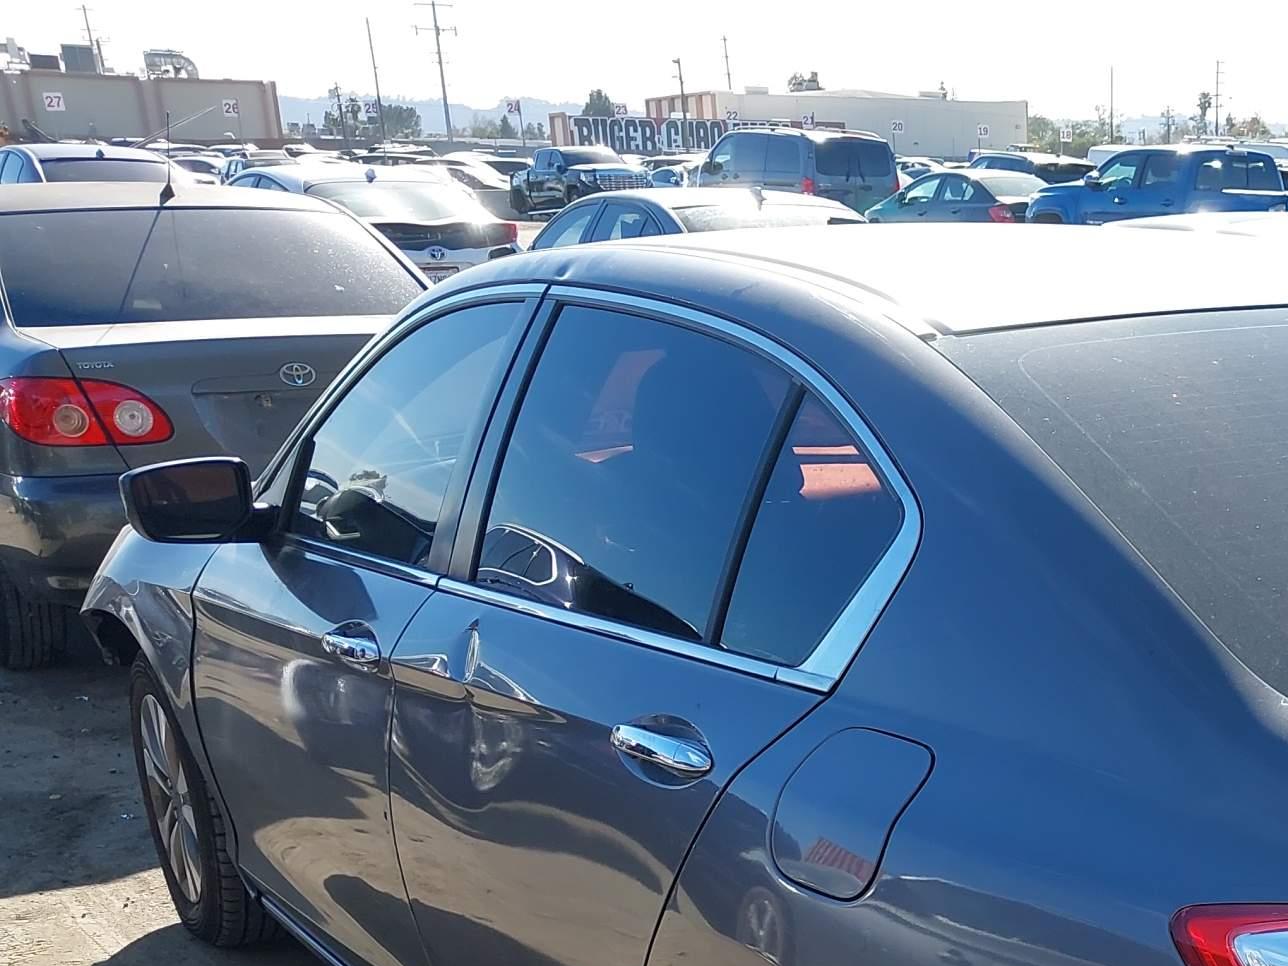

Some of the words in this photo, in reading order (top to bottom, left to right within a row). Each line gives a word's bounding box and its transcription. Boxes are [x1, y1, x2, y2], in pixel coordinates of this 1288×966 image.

[44, 95, 62, 108] 27
[223, 102, 239, 114] 26
[364, 102, 378, 114] 25
[506, 102, 520, 113] 24
[615, 105, 628, 115] 23
[726, 111, 738, 120] 22
[803, 115, 815, 125] 21
[891, 121, 903, 132] 20
[978, 126, 989, 136] 19
[1060, 130, 1072, 140] 18
[76, 361, 115, 369] TOYOTA
